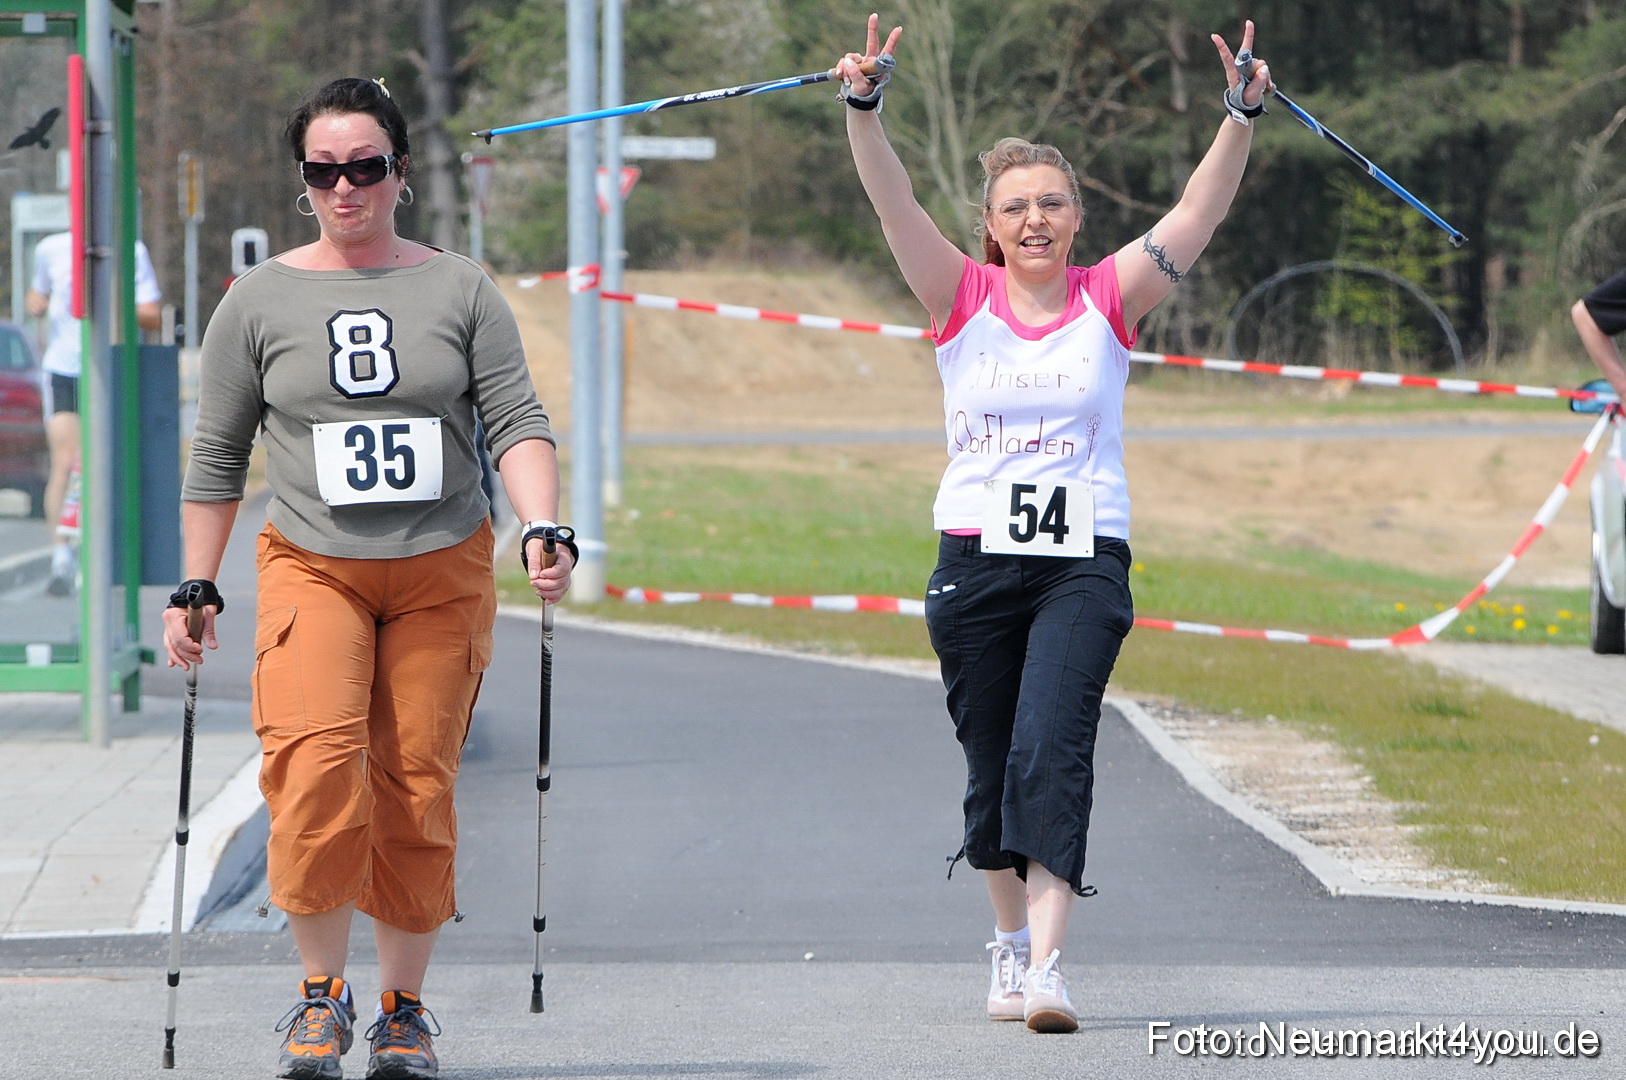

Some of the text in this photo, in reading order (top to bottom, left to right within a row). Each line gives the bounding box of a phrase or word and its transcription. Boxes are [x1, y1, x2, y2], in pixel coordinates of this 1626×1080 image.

[326, 308, 400, 399] 8
[344, 424, 416, 492] 35
[1008, 483, 1070, 545] 54
